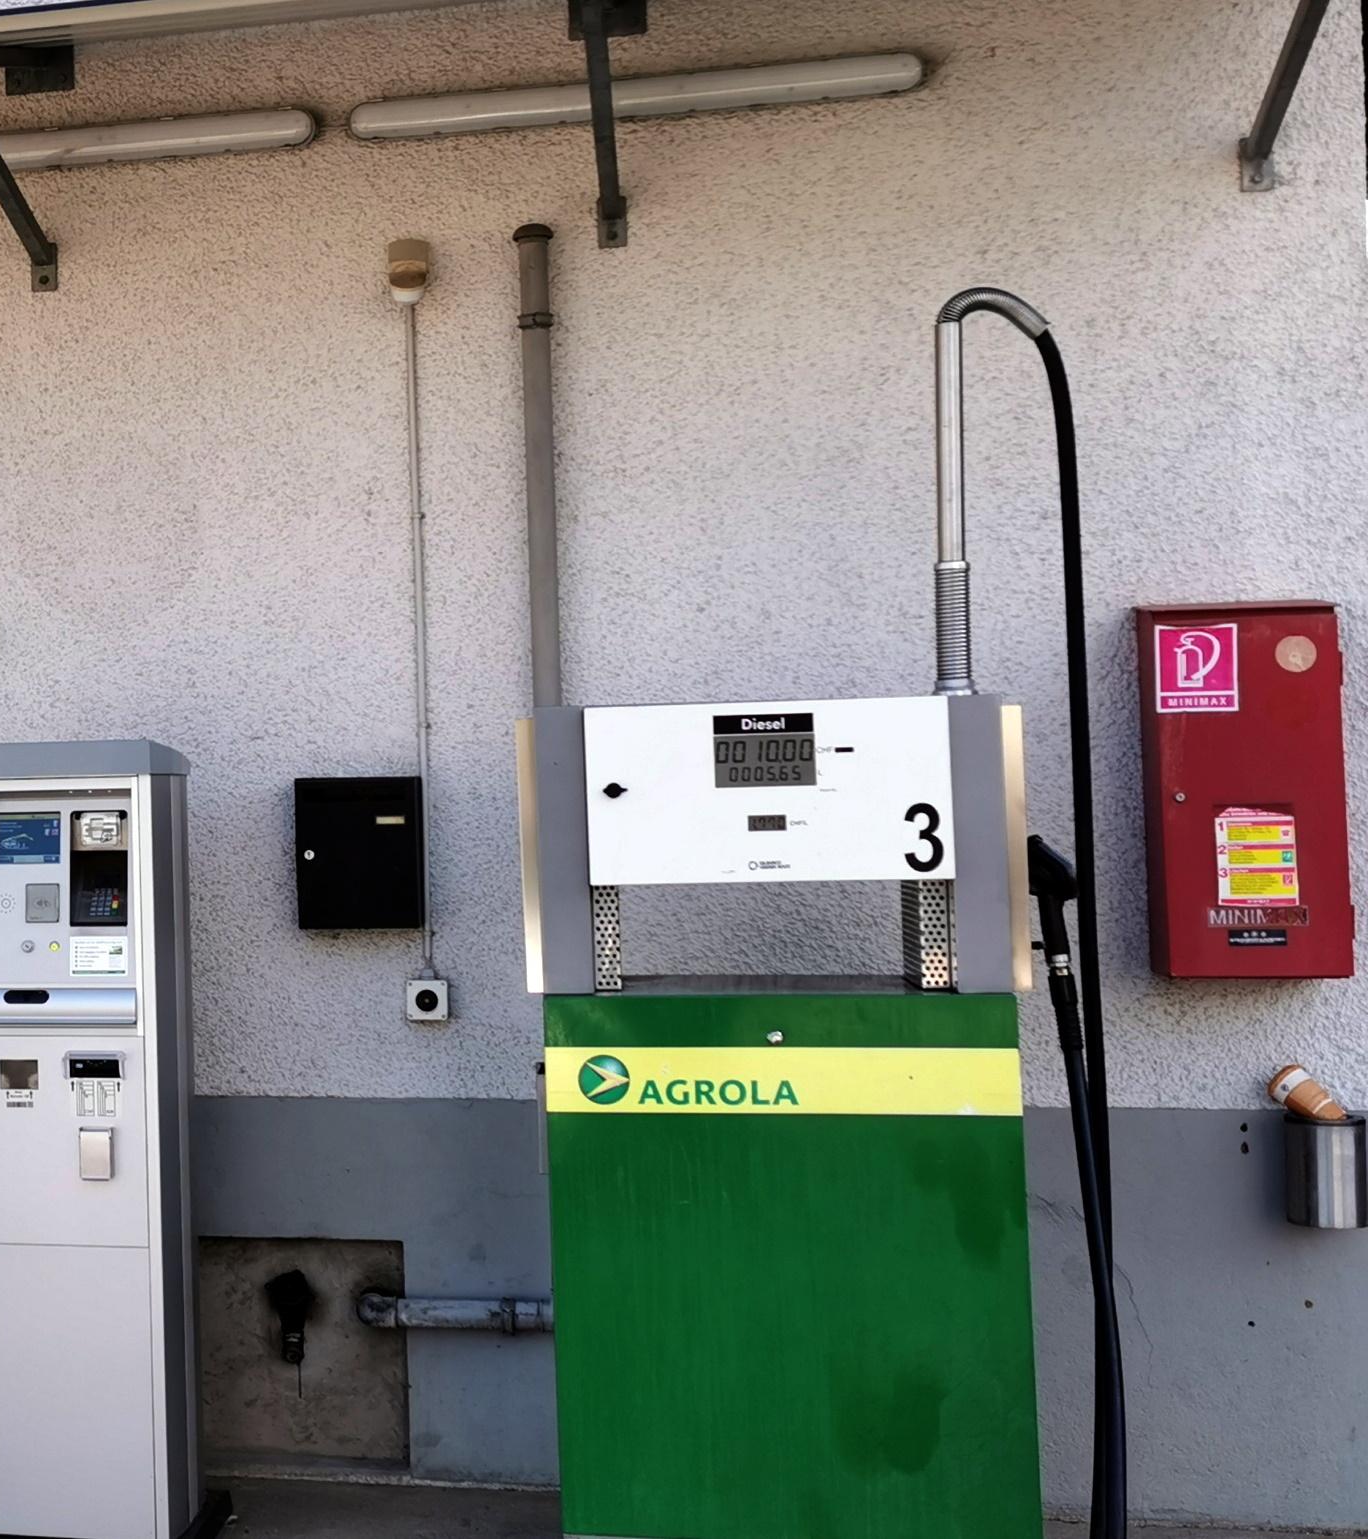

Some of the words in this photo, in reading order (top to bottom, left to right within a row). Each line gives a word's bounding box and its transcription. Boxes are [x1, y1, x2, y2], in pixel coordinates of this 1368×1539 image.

[1168, 696, 1227, 706] MINIMAX
[741, 717, 785, 730] Diesel
[1218, 822, 1224, 831] 1
[904, 803, 944, 872] 3
[1218, 845, 1227, 855] 2
[1219, 868, 1228, 878] 3
[638, 1079, 800, 1106] AGROLA
